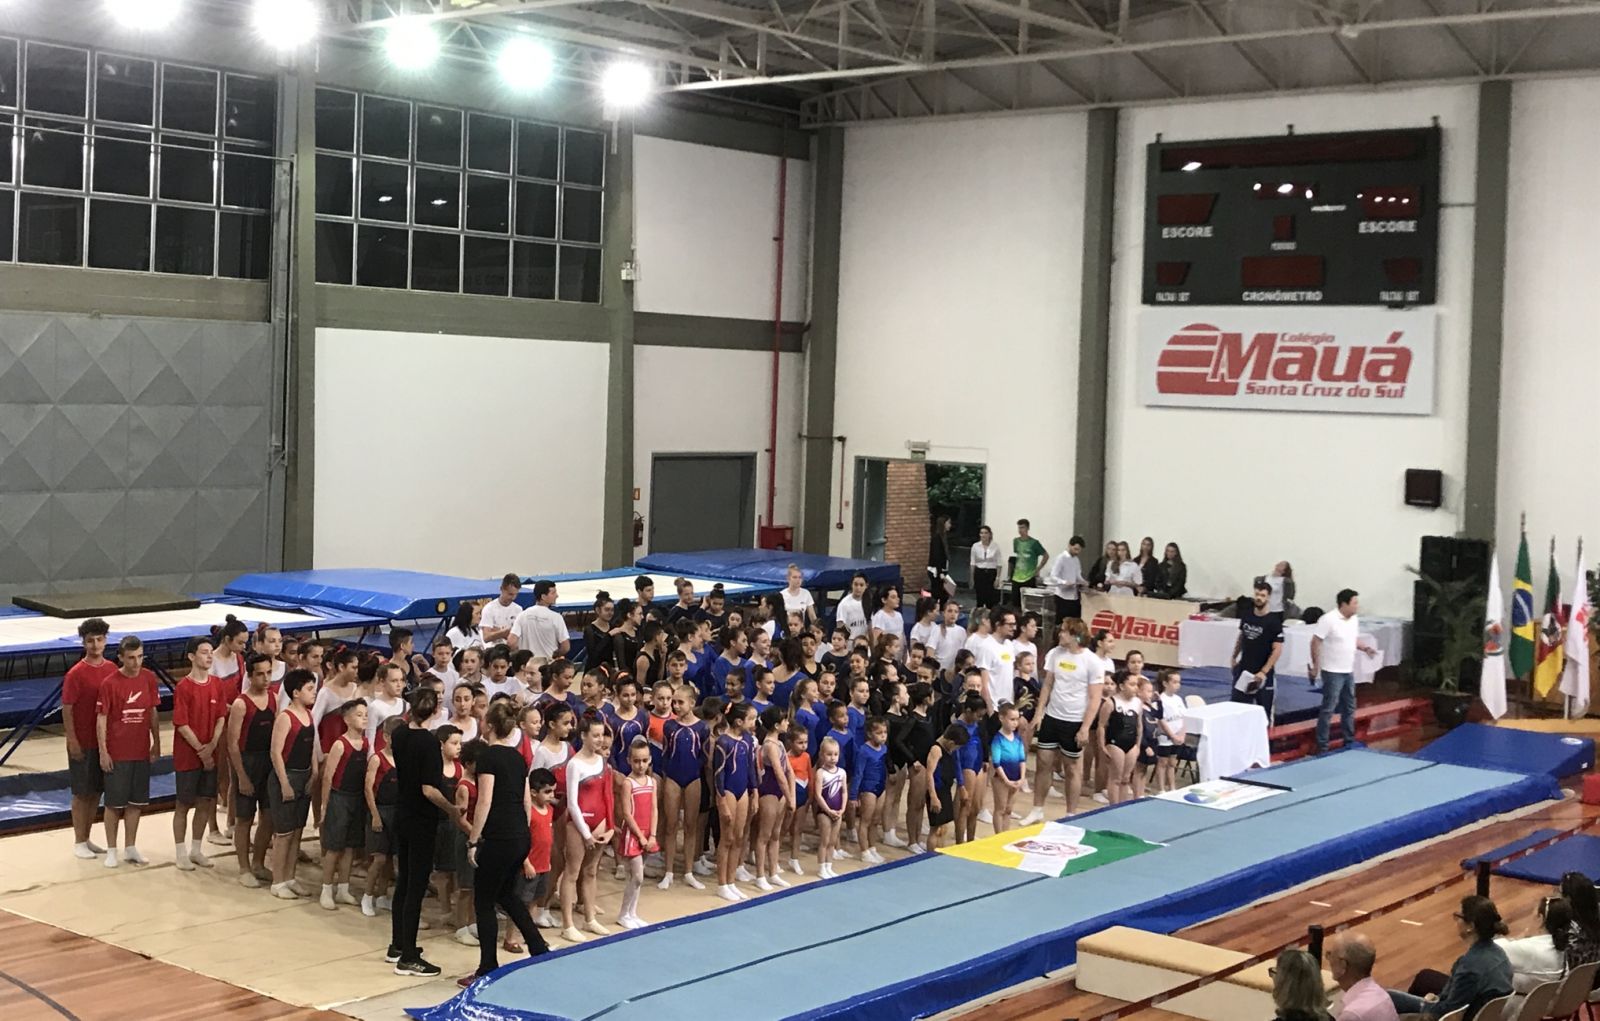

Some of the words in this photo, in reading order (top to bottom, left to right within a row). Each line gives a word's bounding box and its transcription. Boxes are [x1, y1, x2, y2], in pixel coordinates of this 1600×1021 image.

[1162, 226, 1213, 239] ESCORE
[1359, 220, 1417, 233] ESCORE
[1281, 332, 1335, 346] Colégio
[1207, 331, 1413, 384] Mauá
[1245, 382, 1298, 396] Santa
[1302, 384, 1344, 397] Cruz
[1347, 385, 1371, 398] do
[1375, 385, 1406, 399] Sul
[1111, 614, 1179, 641] Mauá
